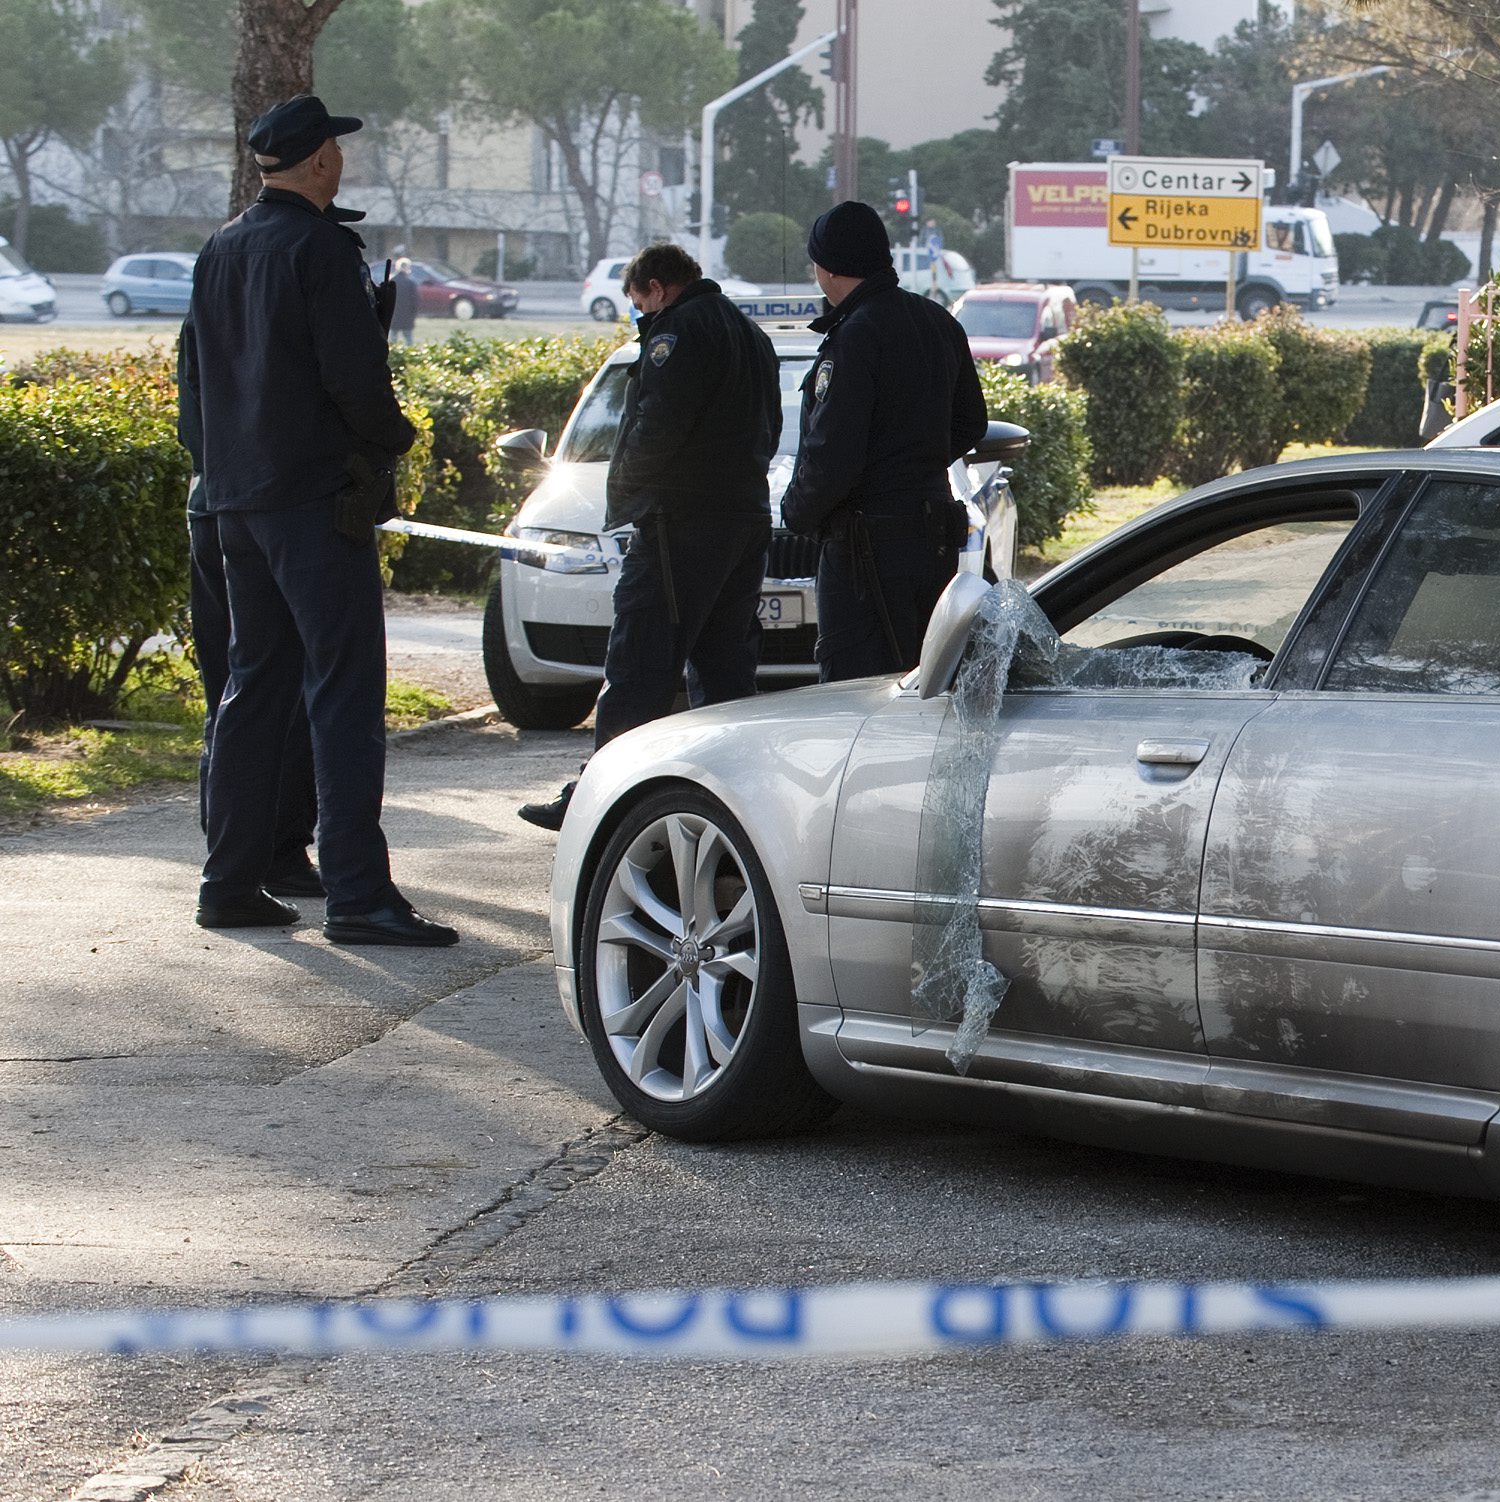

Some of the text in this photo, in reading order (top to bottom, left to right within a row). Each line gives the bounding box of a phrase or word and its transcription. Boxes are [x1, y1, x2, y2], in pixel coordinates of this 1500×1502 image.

[1143, 170, 1226, 190] Centar
[1028, 185, 1108, 203] VELPR
[1146, 200, 1209, 218] Rijeka
[738, 303, 818, 316] OLICIJA
